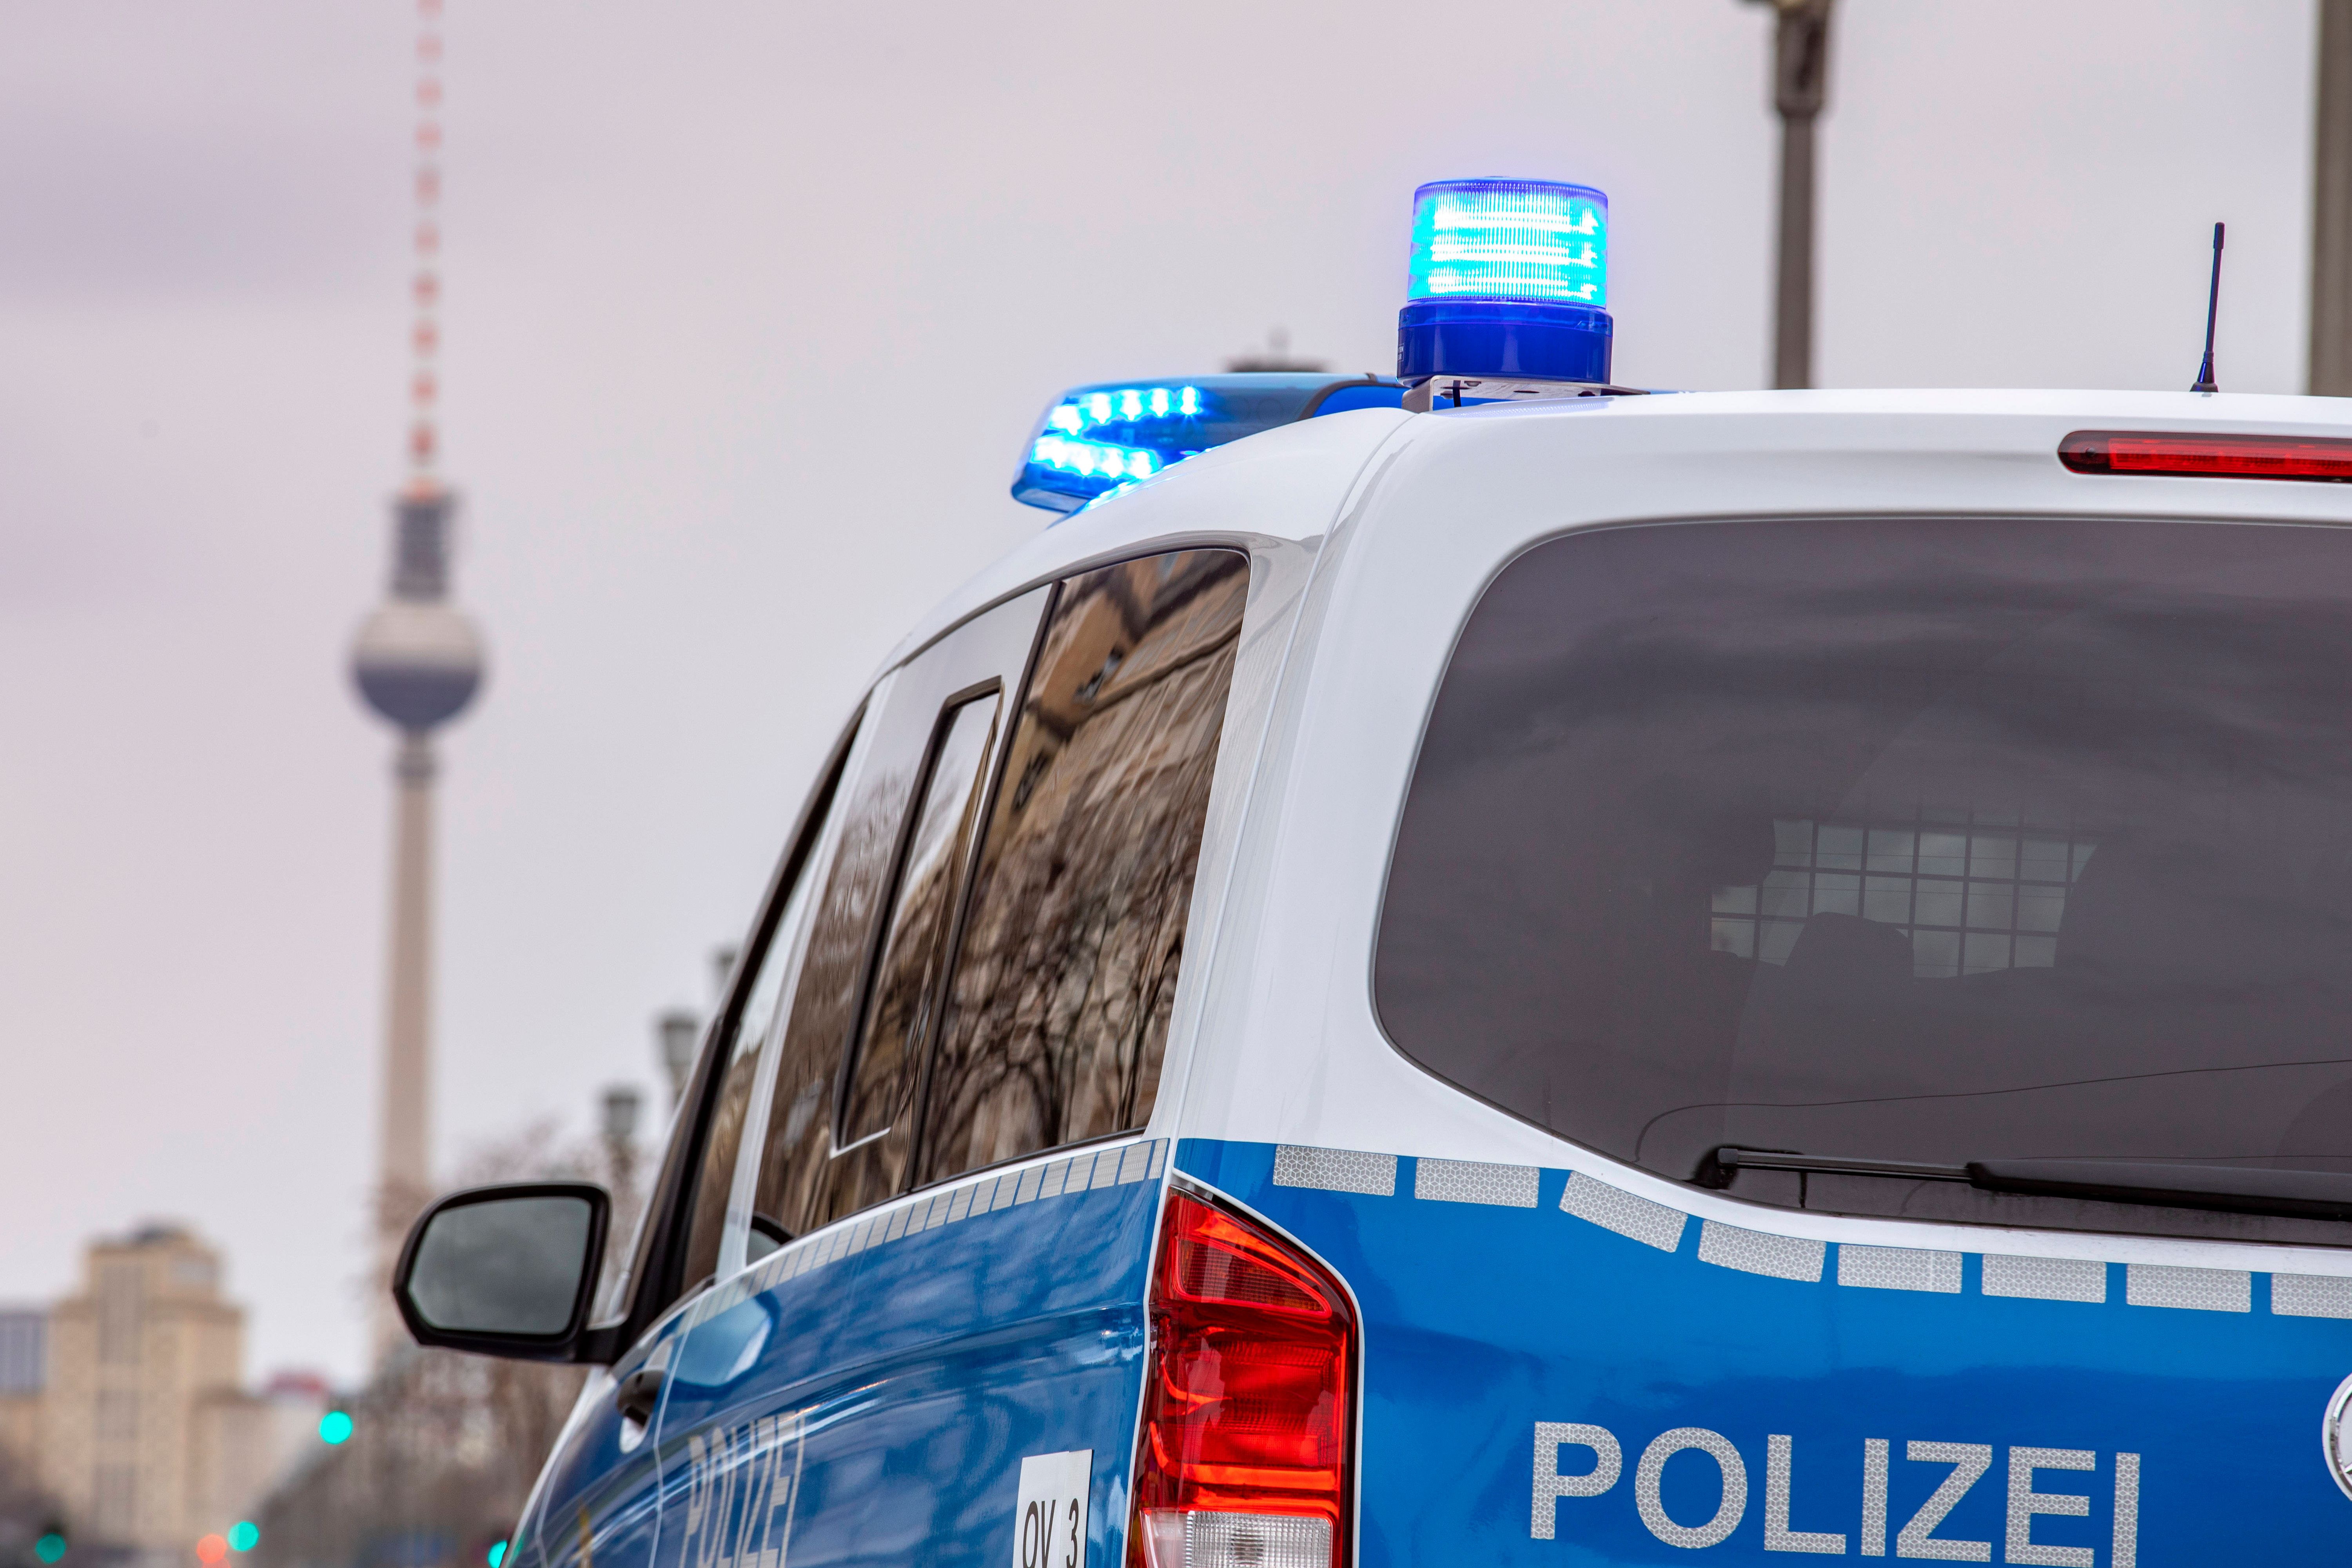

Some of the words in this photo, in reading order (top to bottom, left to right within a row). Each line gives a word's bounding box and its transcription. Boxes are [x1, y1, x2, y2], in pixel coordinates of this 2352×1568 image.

[679, 1408, 805, 1568] POLIZEI
[1023, 1499, 1056, 1568] OV
[1066, 1498, 1079, 1568] 3
[1530, 1421, 2141, 1568] POLIZEI
